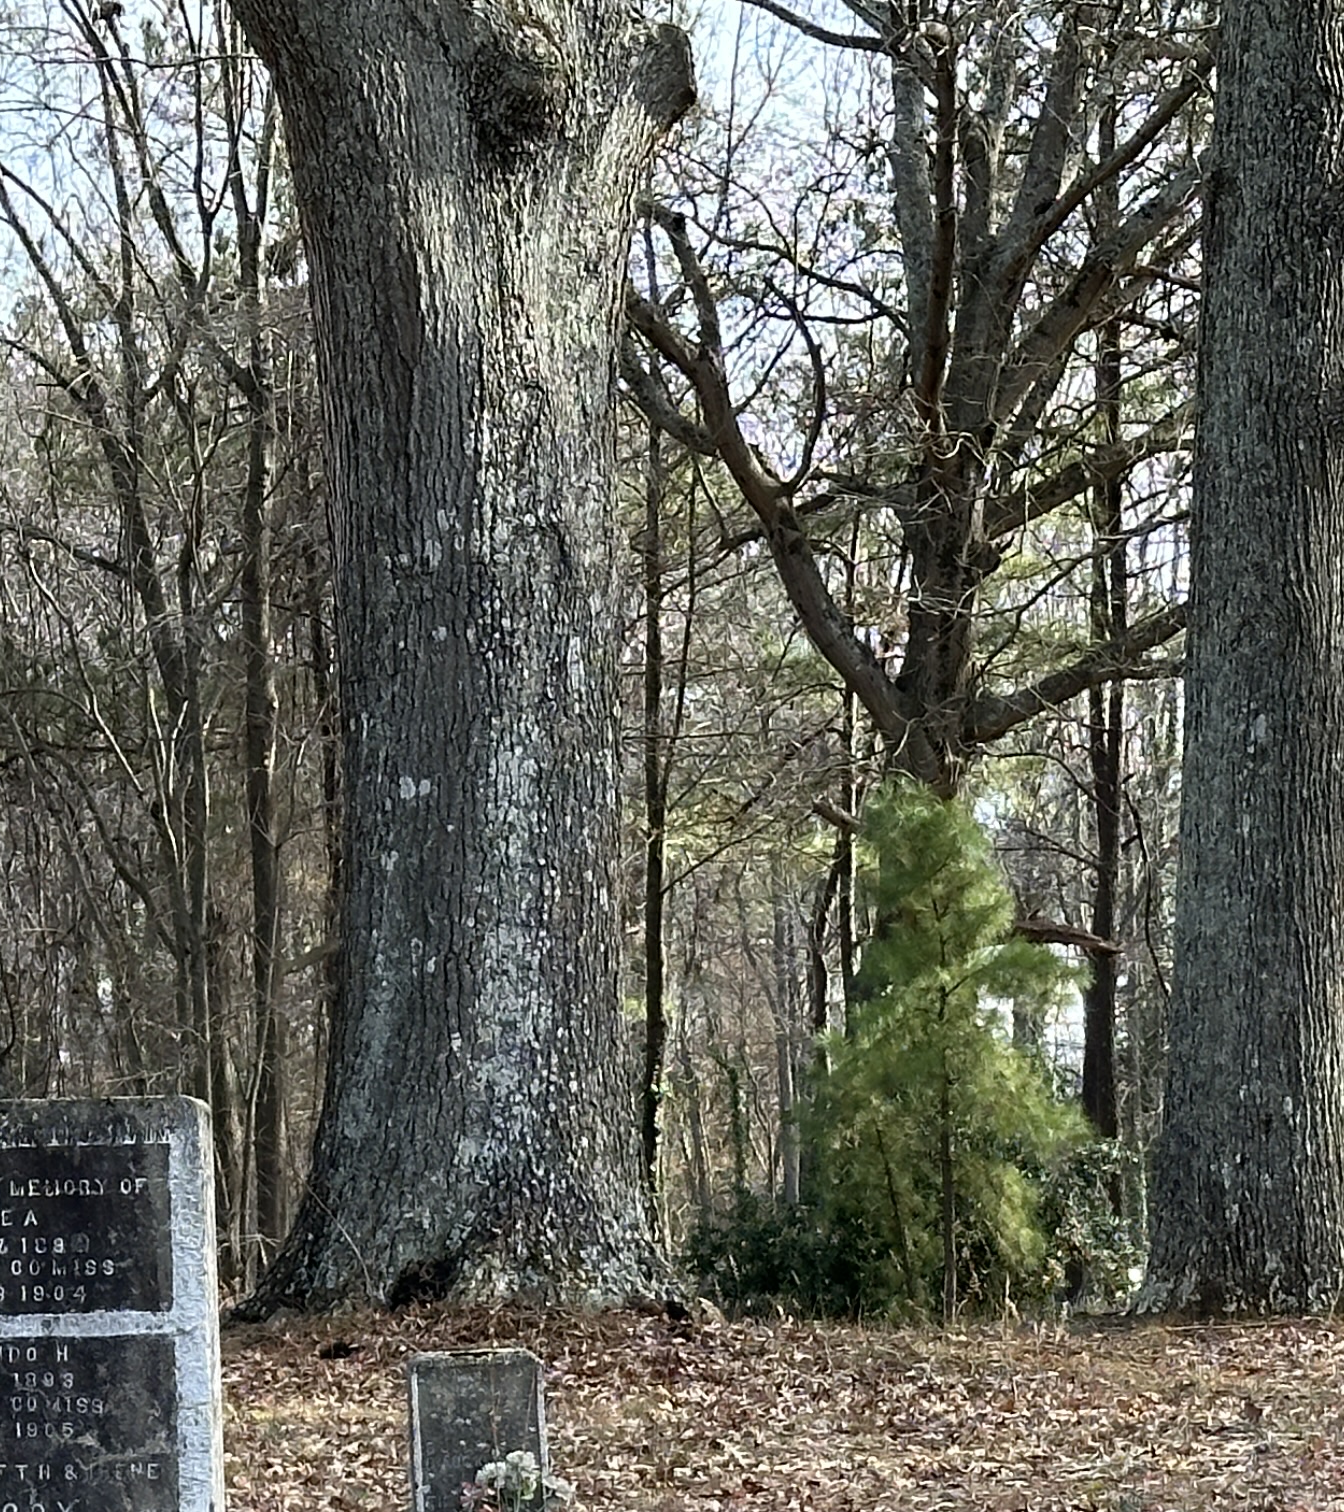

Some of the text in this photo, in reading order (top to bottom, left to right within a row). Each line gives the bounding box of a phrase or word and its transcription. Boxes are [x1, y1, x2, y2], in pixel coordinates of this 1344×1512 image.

[10, 1178, 105, 1197] MEMORY
[120, 1178, 147, 1195] OF
[23, 1209, 38, 1227] A
[11, 1259, 40, 1276] CO
[52, 1259, 116, 1277] MISS
[21, 1285, 87, 1304] 1904
[57, 1344, 69, 1363] H
[12, 1395, 38, 1413] CO
[15, 1421, 74, 1439] 1905
[14, 1464, 29, 1481] T
[64, 1463, 78, 1481] &
[89, 1462, 160, 1481] IENE
